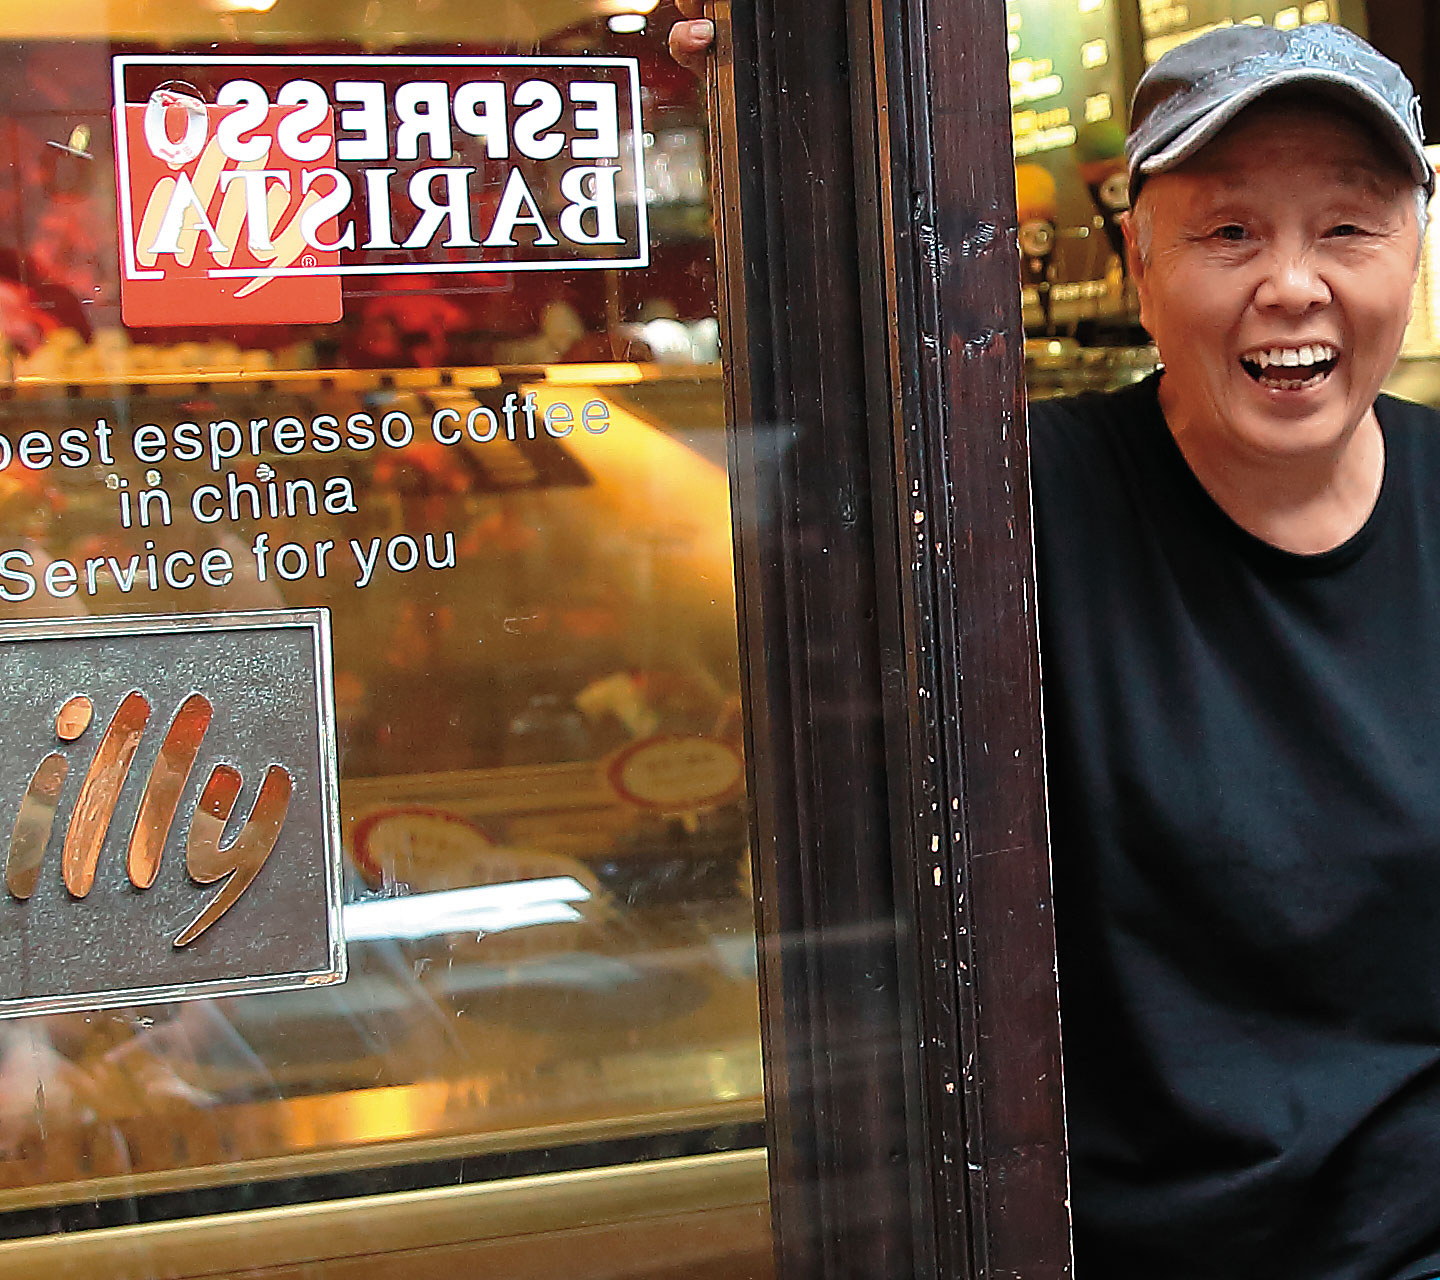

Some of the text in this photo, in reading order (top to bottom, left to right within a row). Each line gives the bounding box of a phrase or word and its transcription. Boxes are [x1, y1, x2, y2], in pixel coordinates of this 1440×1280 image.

[132, 410, 414, 471] espresso
[430, 392, 611, 446] coffee
[118, 470, 358, 529] in china
[252, 532, 334, 582] for
[350, 531, 456, 588] you
[5, 688, 294, 947] illy
